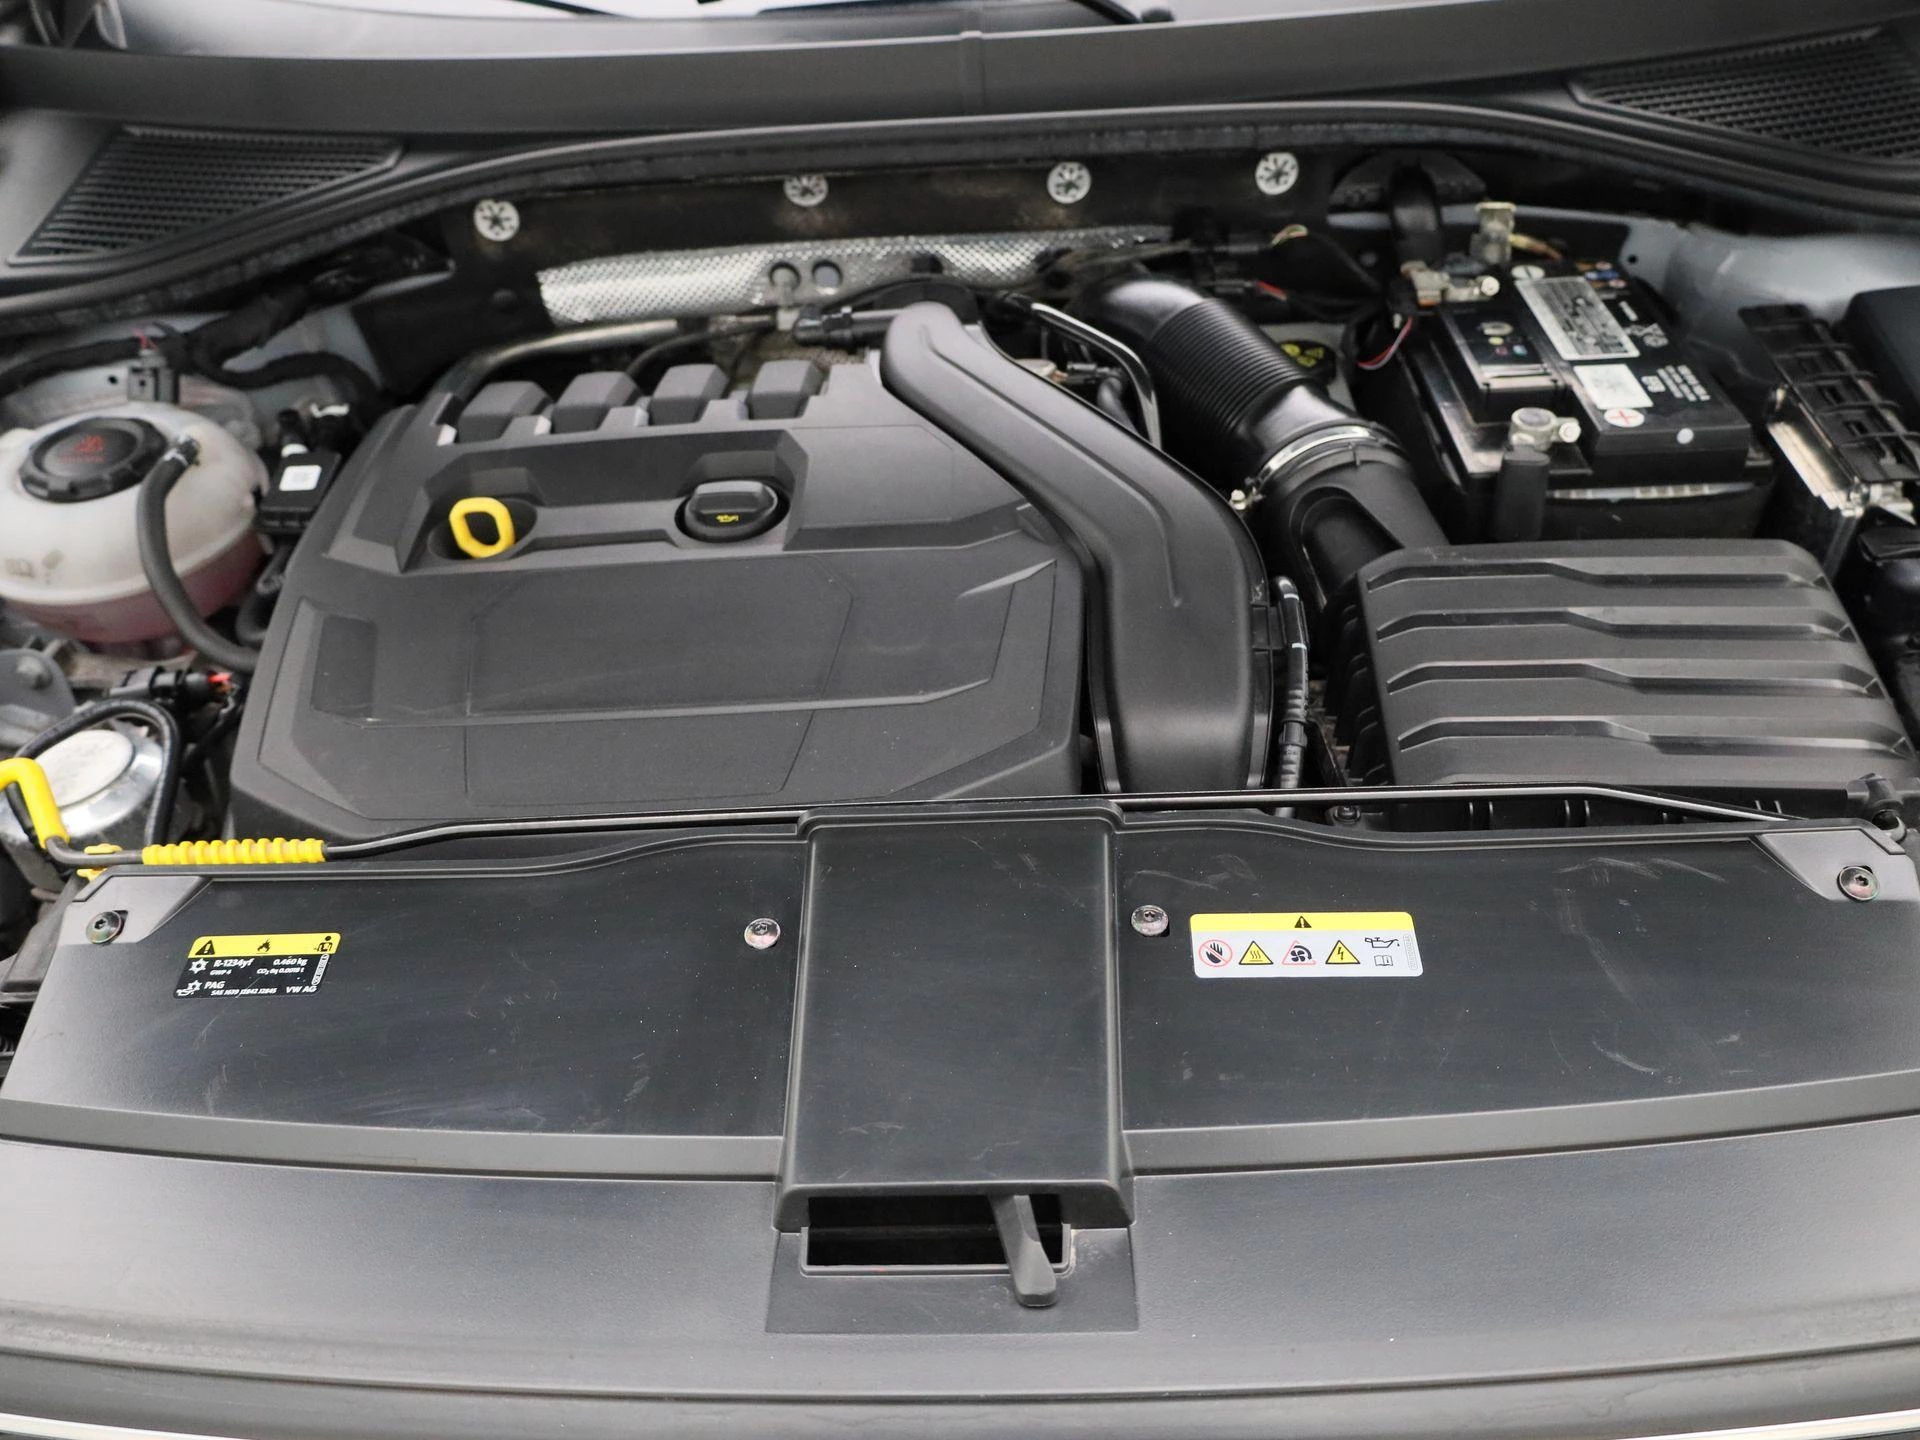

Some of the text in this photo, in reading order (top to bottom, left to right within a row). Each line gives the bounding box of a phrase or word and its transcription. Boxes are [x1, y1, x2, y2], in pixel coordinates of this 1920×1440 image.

[213, 958, 255, 969] R-1234yf
[297, 957, 308, 966] kg
[204, 980, 226, 989] PAG
[302, 985, 317, 993] AG
